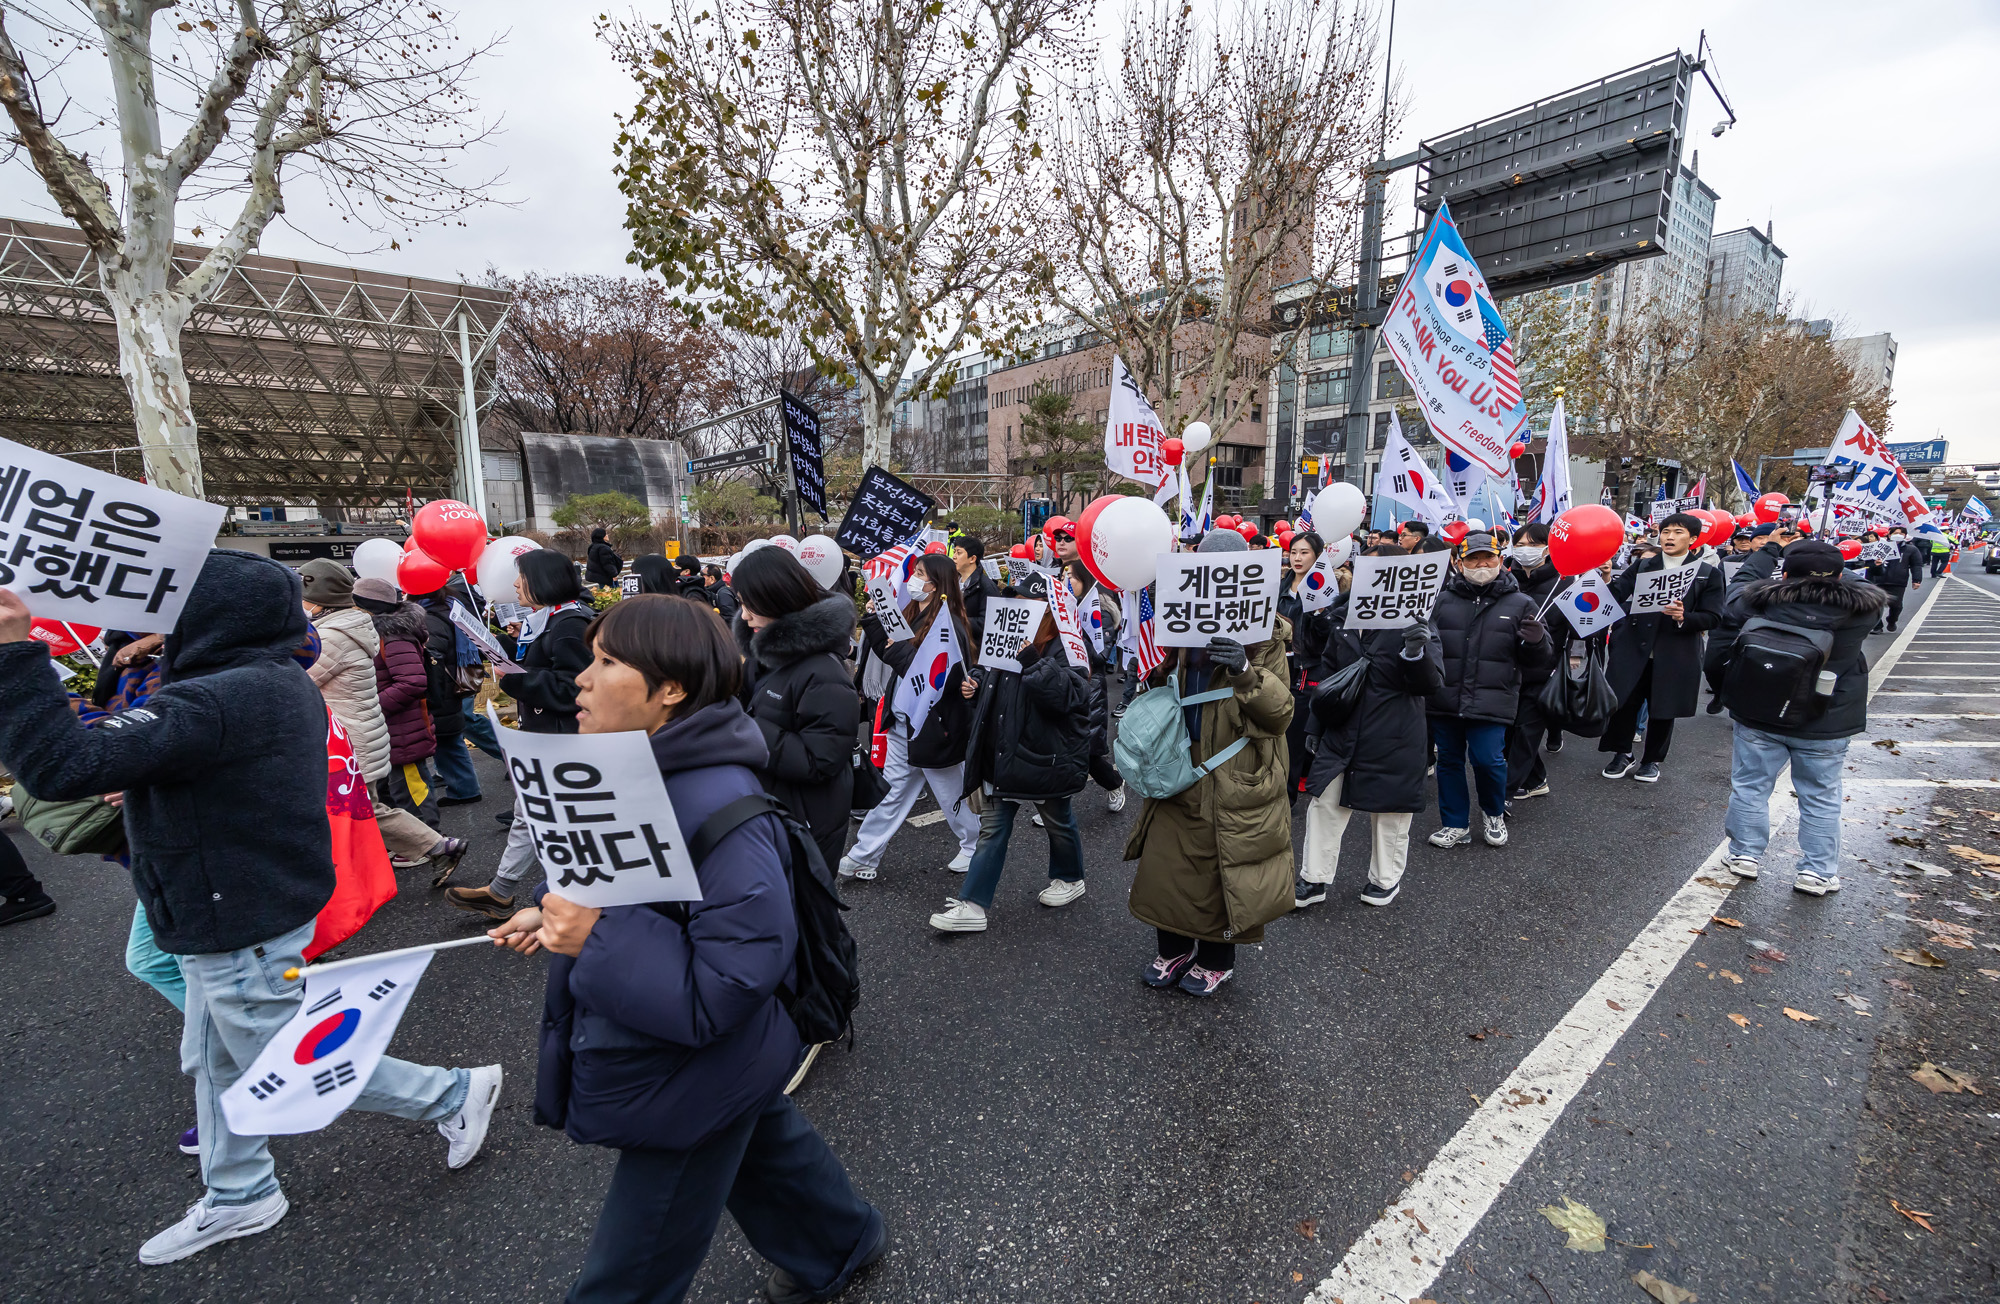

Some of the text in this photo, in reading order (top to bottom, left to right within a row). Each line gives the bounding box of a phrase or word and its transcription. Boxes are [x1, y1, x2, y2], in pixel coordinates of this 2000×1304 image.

[1465, 351, 1488, 370] 6.25
[1459, 419, 1507, 460] Freedom!
[1908, 452, 1925, 460] 전국
[440, 502, 472, 513] FREE
[871, 474, 928, 514] 부정선거
[440, 510, 480, 522] YOON
[1178, 564, 1265, 599] 계엄은
[1371, 563, 1438, 593] 계엄은
[1649, 568, 1695, 591] 계엄은
[993, 607, 1031, 634] 계엄은
[1162, 596, 1273, 634] 정당했다
